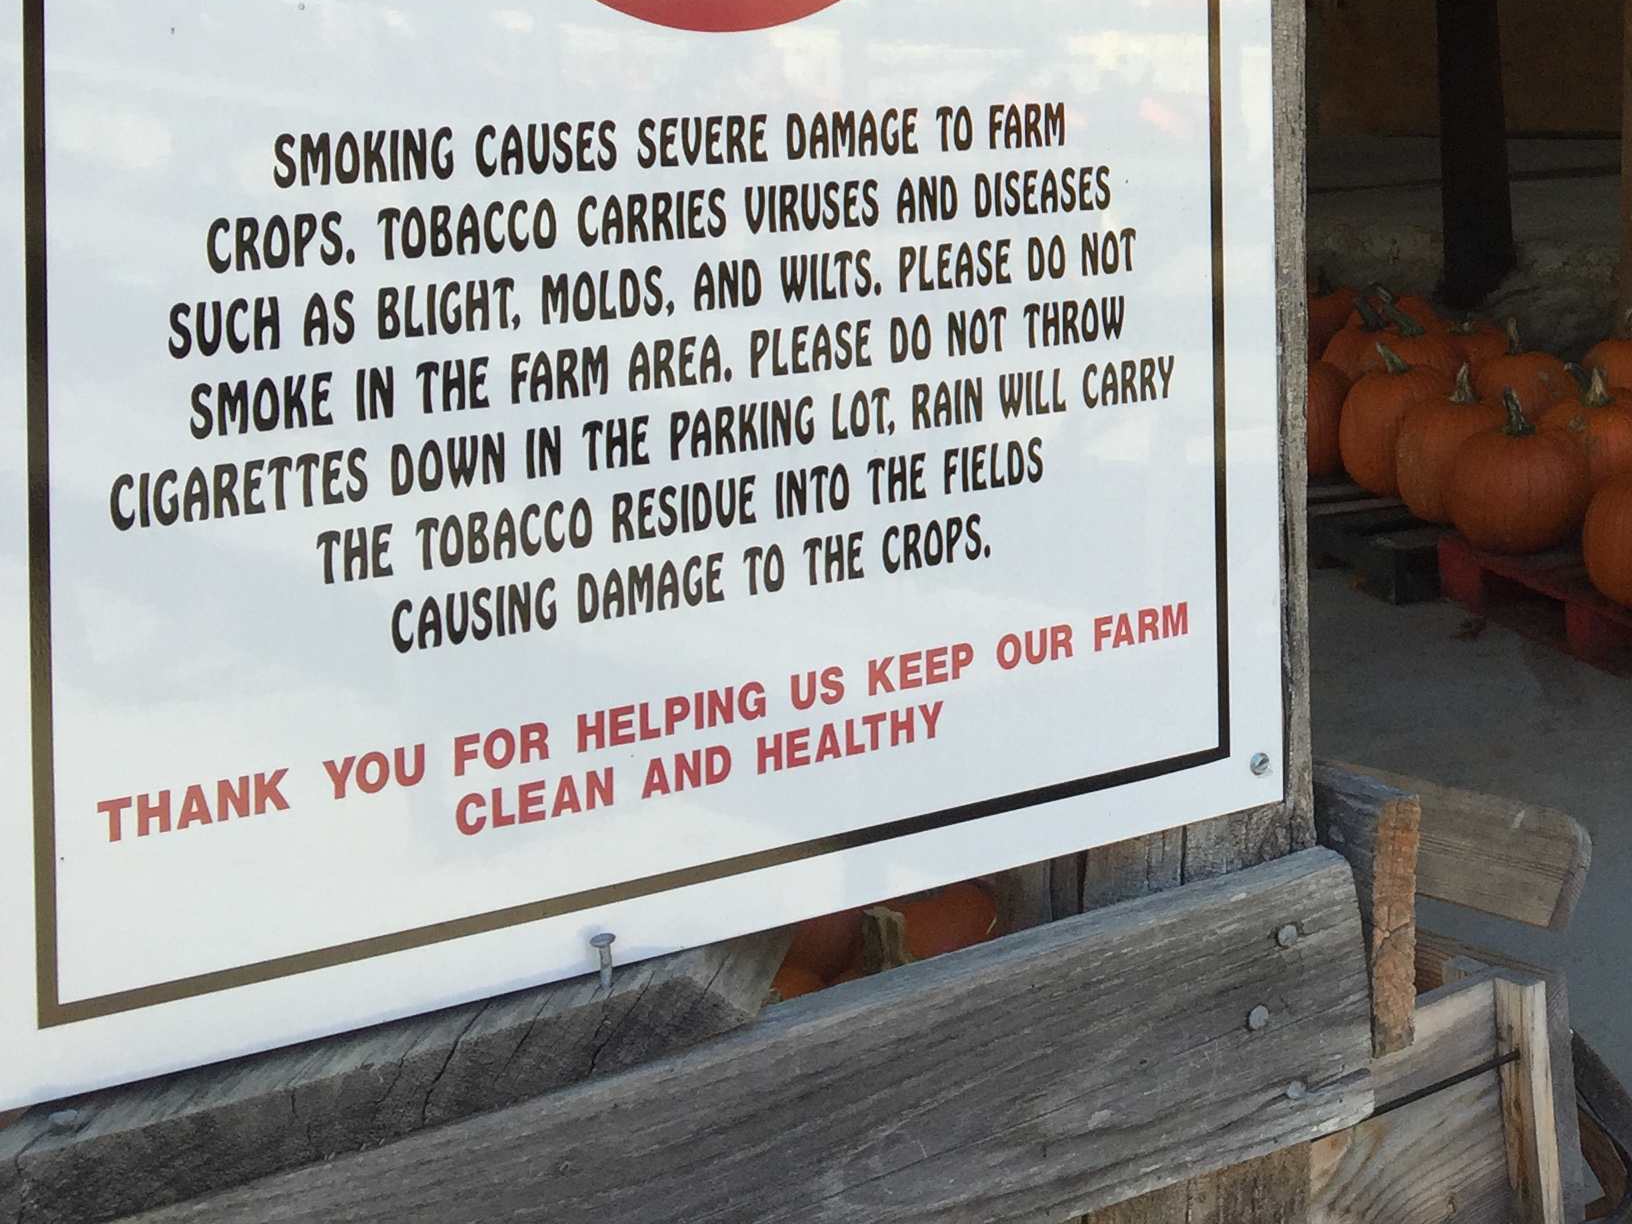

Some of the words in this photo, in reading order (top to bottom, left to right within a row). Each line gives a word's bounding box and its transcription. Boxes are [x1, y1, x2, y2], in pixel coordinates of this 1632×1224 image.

[274, 127, 453, 188] SMOKING
[476, 120, 617, 177] CAUSES
[638, 114, 768, 168] SEVERE
[787, 108, 918, 160] DAMAGE
[936, 106, 972, 151] TO
[989, 102, 1065, 149] FARM
[207, 211, 355, 273] CROPS.
[377, 199, 556, 260] TOBACCO
[578, 188, 726, 247] CARRIES
[745, 179, 879, 234] VIRUSES
[897, 175, 957, 223] AND
[975, 166, 1110, 218] DISEASES
[169, 296, 280, 359] SUCH
[304, 290, 354, 346] AS
[378, 277, 520, 339] BLIGHT,
[542, 266, 674, 325] MOLDS,
[694, 259, 761, 311] AND
[781, 249, 881, 303] WILTS.
[900, 239, 1012, 292] PLEASE
[1028, 235, 1065, 281] DO
[1082, 228, 1136, 276] NOT
[190, 372, 333, 439] SMOKE
[356, 366, 394, 421] IN
[416, 357, 490, 414] THE
[511, 345, 608, 404] FARM
[629, 335, 732, 391] AREA.
[751, 320, 872, 378] PLEASE
[891, 314, 931, 363] DO
[948, 307, 1006, 357] NOT
[1024, 296, 1124, 348] THROW
[110, 448, 367, 531] CIGARETTES
[391, 432, 505, 496] DOWN
[526, 425, 561, 479] IN
[582, 415, 650, 471] THE
[671, 396, 814, 460] PARKING
[833, 388, 895, 440] LOT,
[913, 377, 982, 430] RAIN
[999, 368, 1066, 419] WILL
[1083, 355, 1174, 408] CARRY
[317, 524, 393, 584] THE
[416, 498, 592, 570] TOBACCO
[613, 475, 756, 543] RESIDUE
[776, 463, 849, 519] INTO
[867, 453, 926, 505] THE
[944, 437, 1043, 494] FIELDS
[392, 578, 556, 653] CAUSING
[578, 553, 724, 623] DAMAGE
[743, 544, 784, 595] TO
[803, 531, 864, 585] THE
[883, 514, 990, 574] CROPS.
[98, 769, 290, 842] THANK
[323, 744, 424, 799] YOU
[455, 723, 549, 776] FOR
[578, 682, 767, 752] HELPING
[791, 667, 844, 710] US
[869, 643, 973, 696] KEEP
[997, 625, 1072, 669] OUR
[1095, 602, 1187, 651] FARM
[456, 767, 613, 835] CLEAN
[642, 746, 731, 799] AND
[757, 701, 943, 774] HEALTHY
